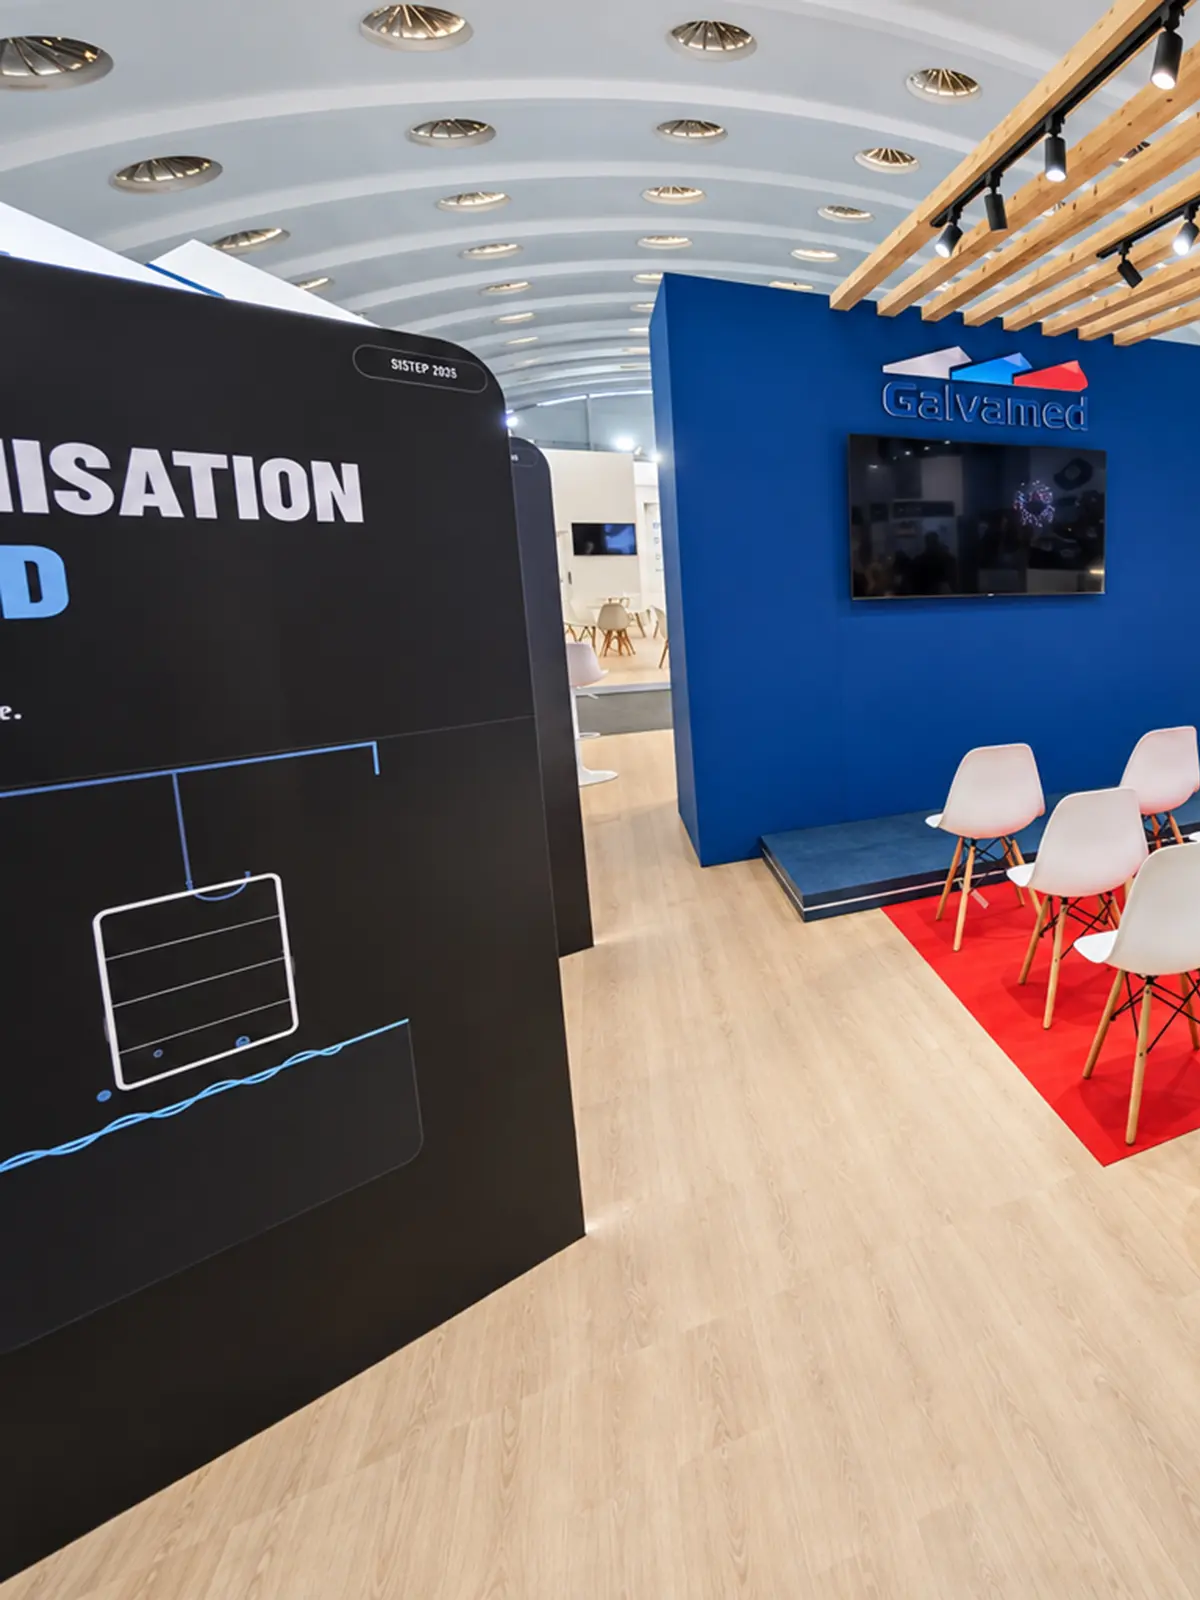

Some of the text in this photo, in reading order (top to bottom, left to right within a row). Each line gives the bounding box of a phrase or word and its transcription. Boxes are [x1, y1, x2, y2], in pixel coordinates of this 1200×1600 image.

[391, 358, 429, 374] SISTEP
[882, 381, 1089, 431] Galvamed
[0, 438, 364, 523] ISATION
